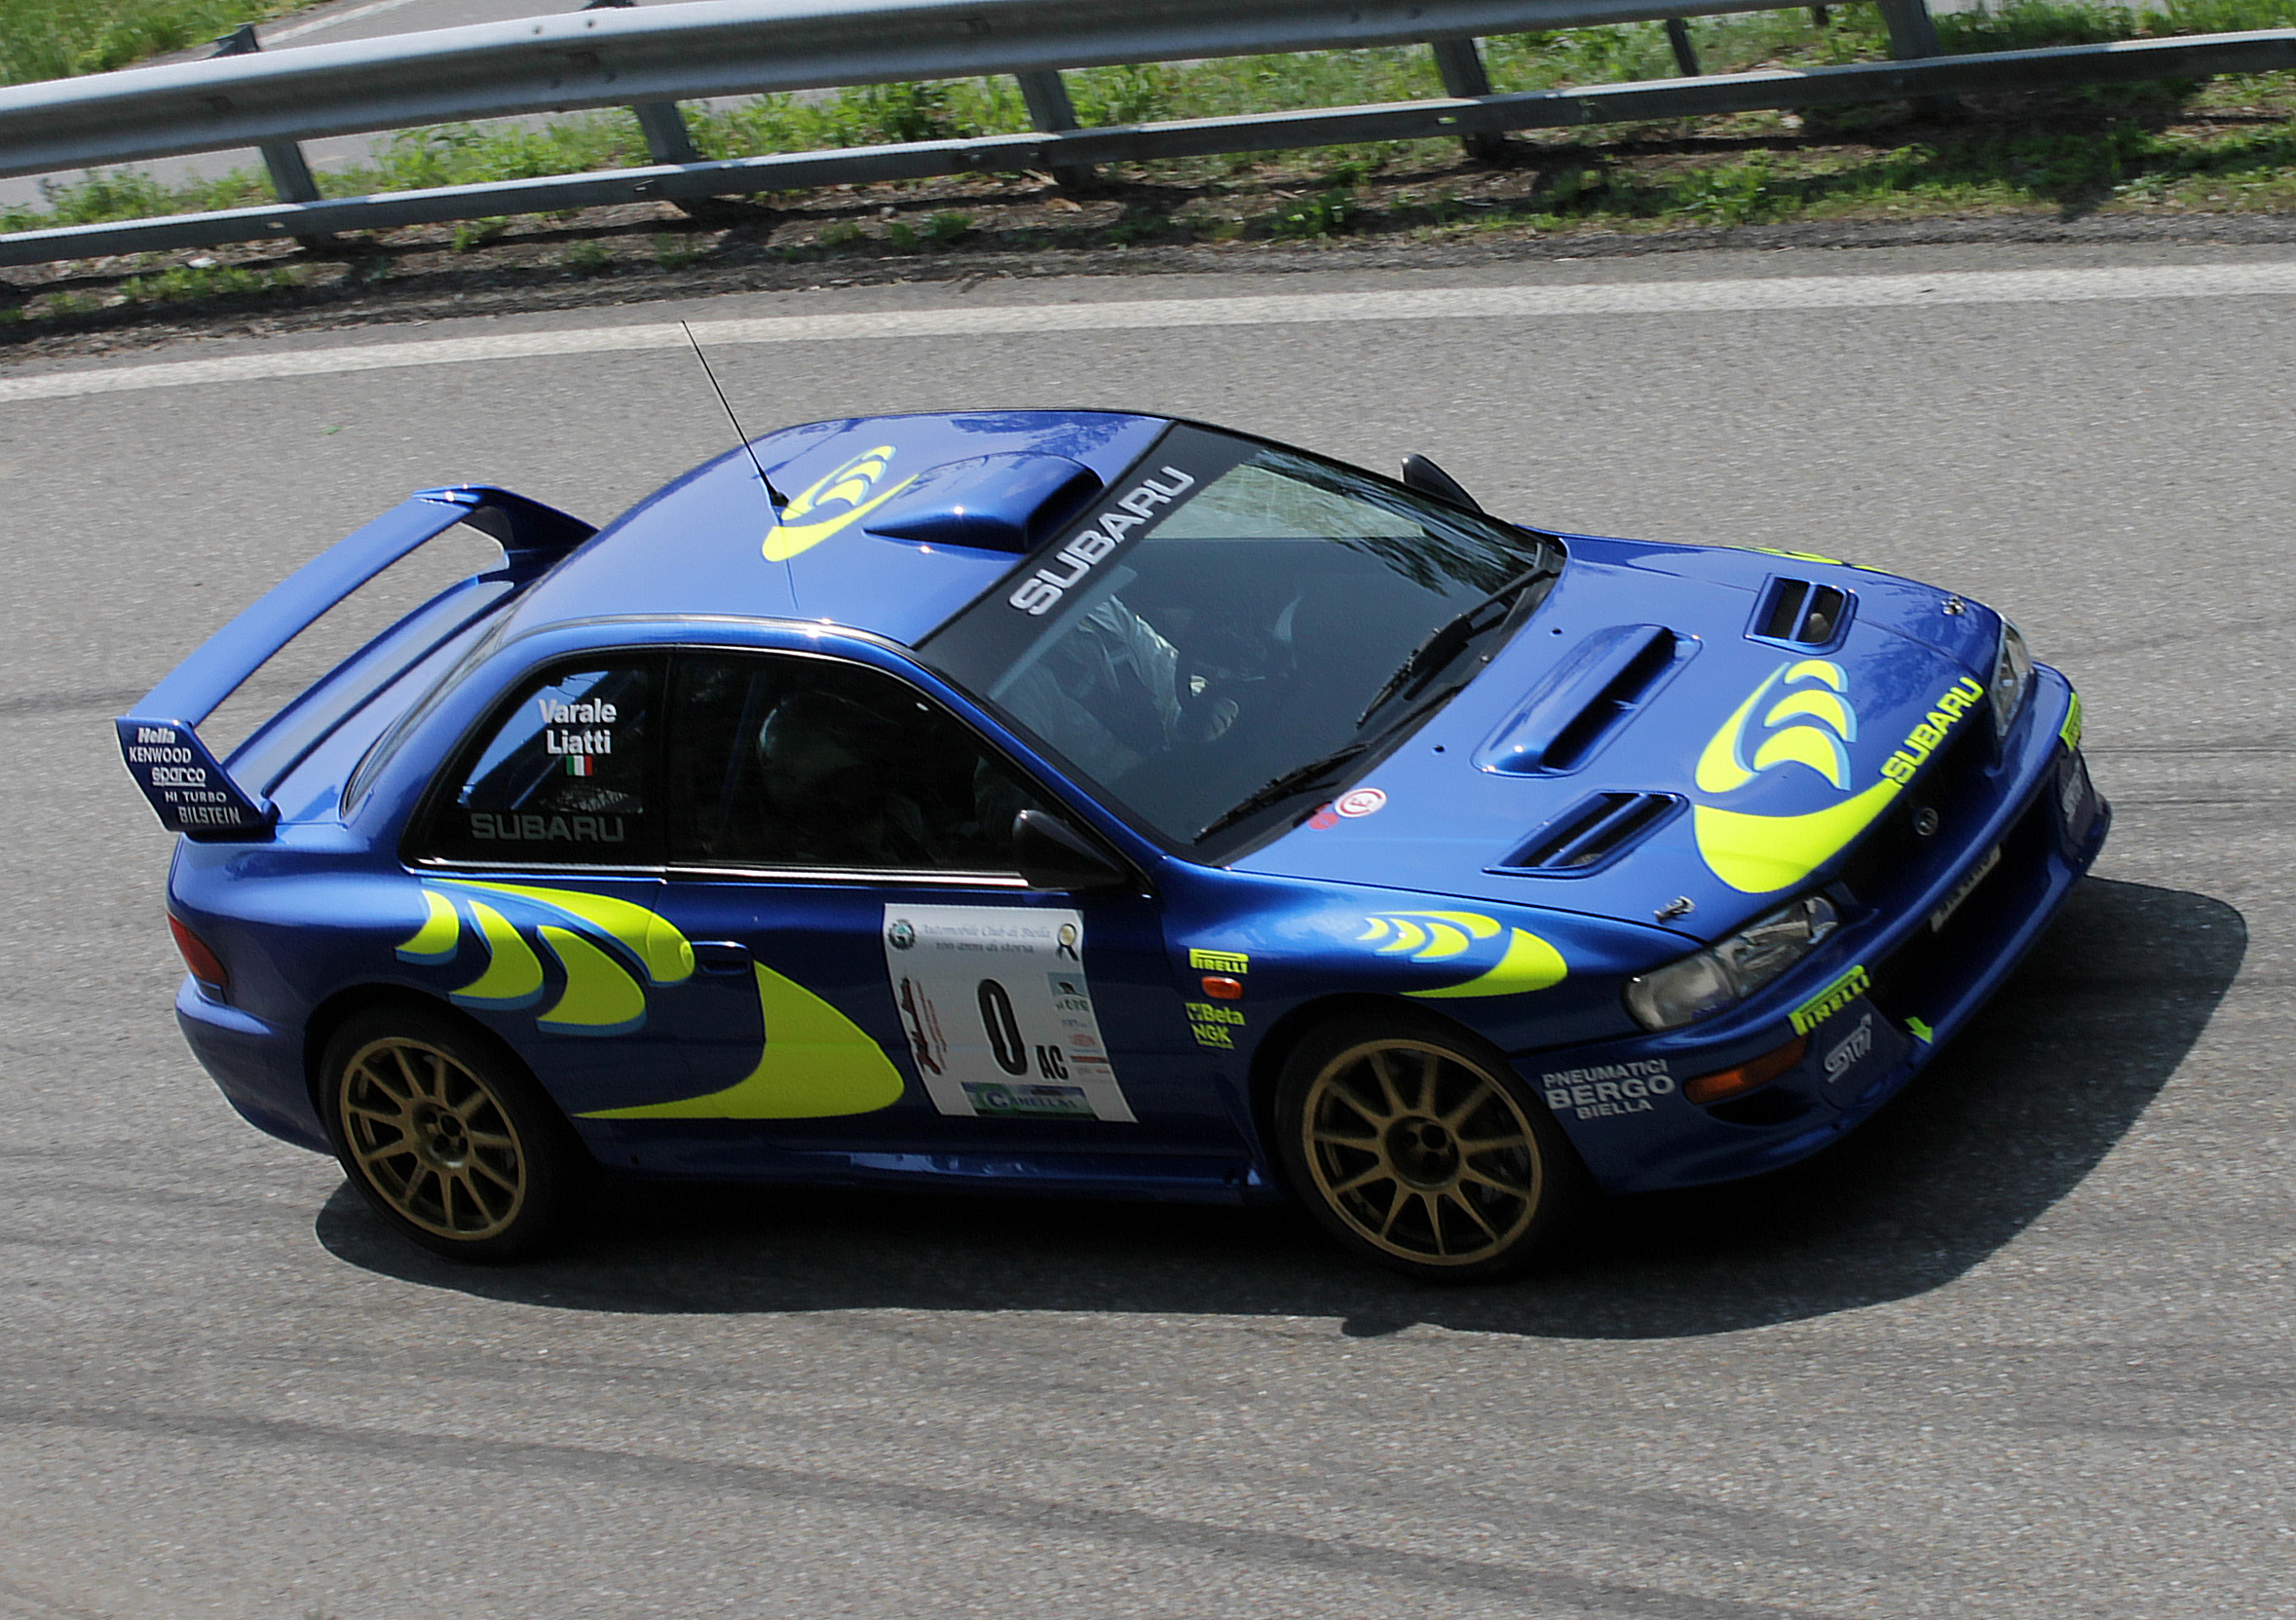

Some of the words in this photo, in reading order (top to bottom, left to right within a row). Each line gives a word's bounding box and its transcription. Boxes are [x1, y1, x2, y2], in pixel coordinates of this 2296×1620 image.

[1009, 466, 1196, 616] SUBARU
[538, 697, 618, 724] Varale
[136, 727, 176, 744] Hella
[546, 729, 613, 754] Liatti
[1880, 676, 1985, 784] SUBARU
[129, 746, 193, 764] KENWOOD
[151, 766, 207, 783] sparco
[164, 790, 178, 803] HI
[181, 790, 228, 803] TURBO
[177, 805, 243, 824] BILSTEIN
[470, 812, 625, 843] SUBARU
[1189, 948, 1249, 974] PIRELLI
[1788, 964, 1870, 1036] PIRELLI
[977, 978, 1029, 1076] 0
[1190, 1023, 1234, 1044] NGK
[1035, 1044, 1070, 1079] AC
[1541, 1058, 1670, 1089] PNEUMATICI
[1545, 1074, 1676, 1110] BERGO
[1576, 1099, 1654, 1120] BIELLA
